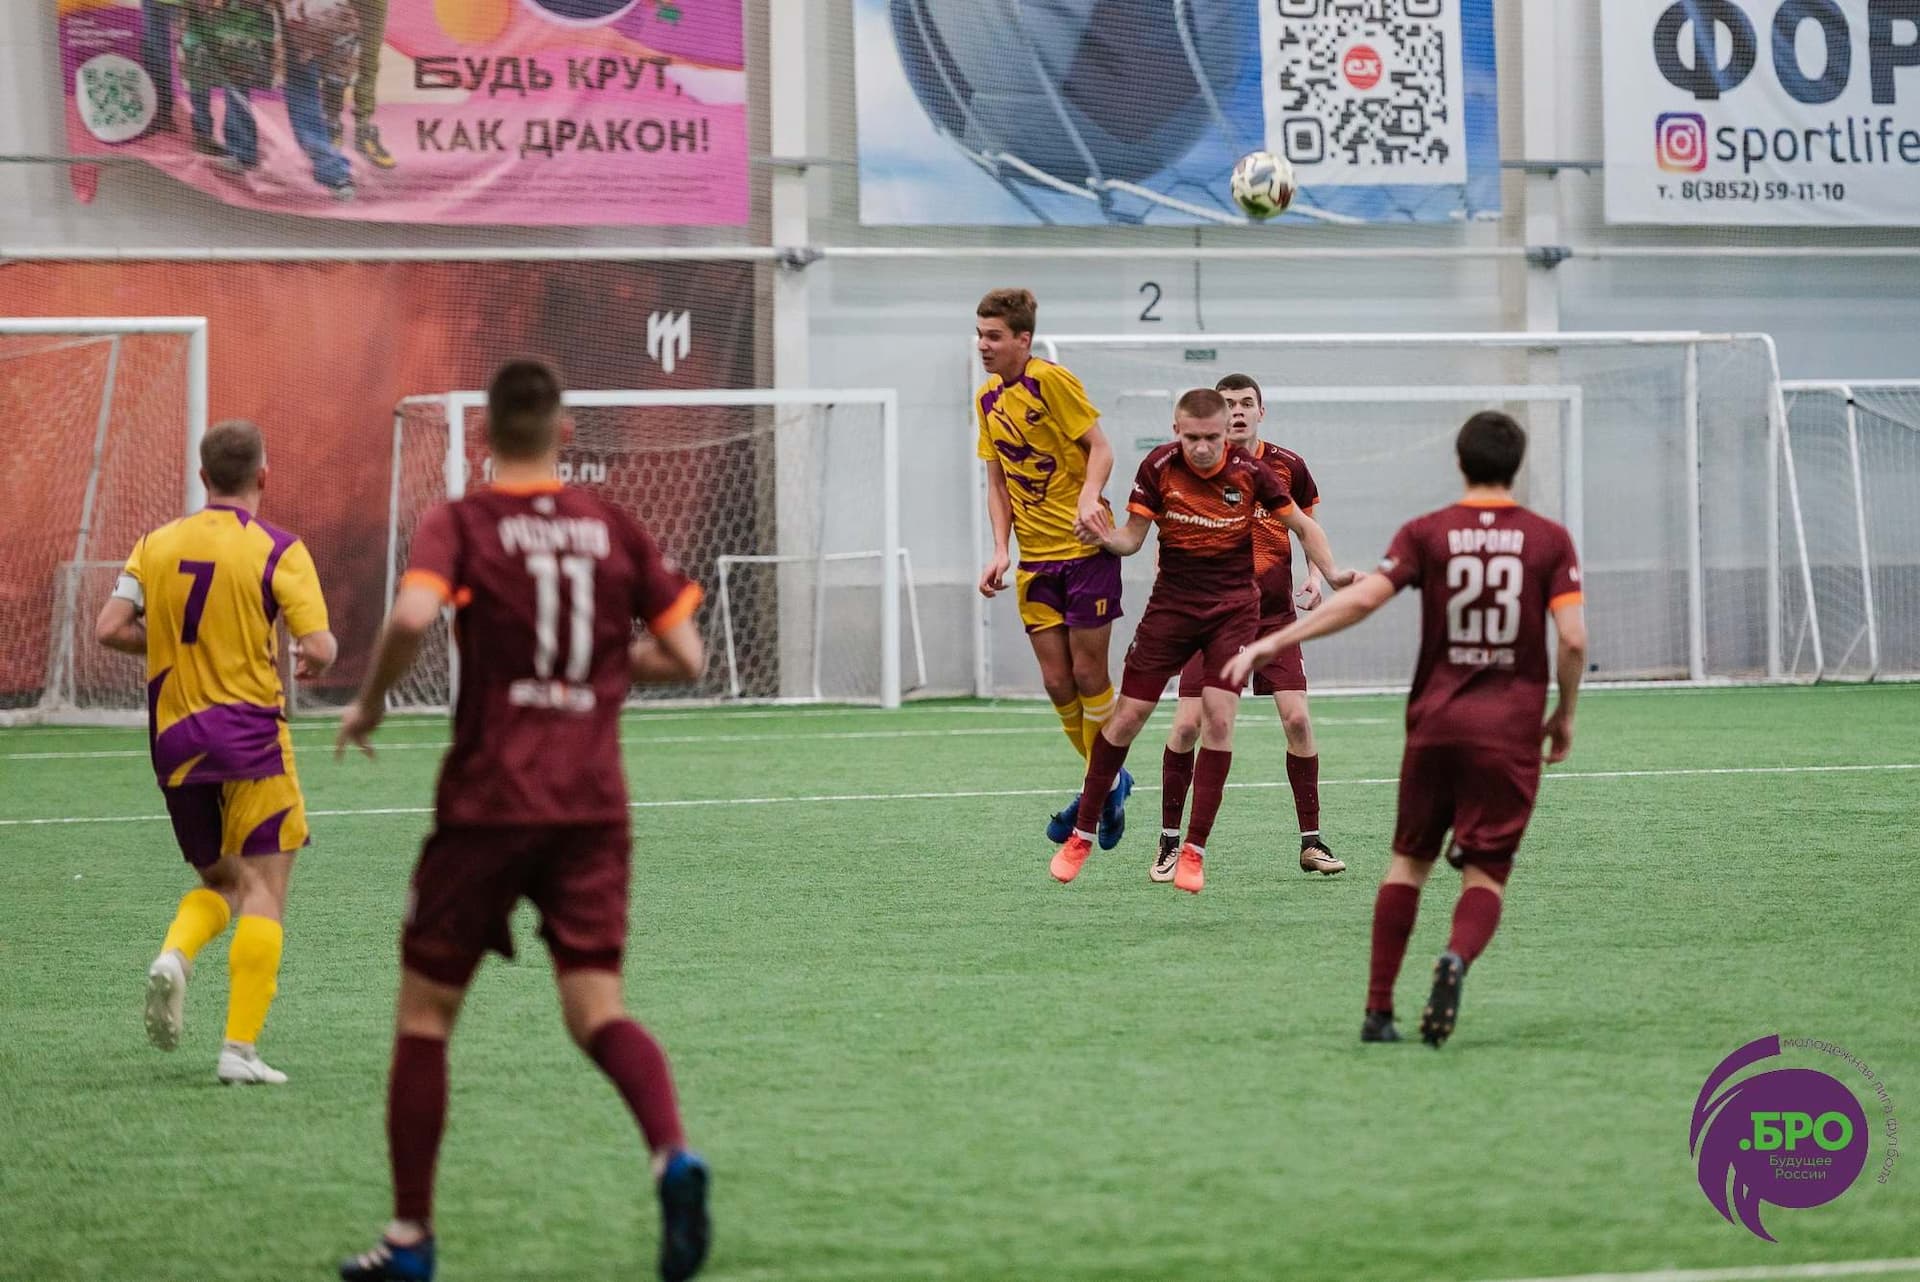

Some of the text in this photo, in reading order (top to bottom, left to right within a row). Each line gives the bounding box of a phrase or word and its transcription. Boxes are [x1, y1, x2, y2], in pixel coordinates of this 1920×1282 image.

[413, 56, 682, 97] БУДЬ КРУТ,
[416, 118, 710, 159] КАК ДРАКОН!
[1715, 117, 1920, 174] sportlife
[1682, 181, 1759, 201] 8(3852)
[1764, 183, 1845, 202] 59-11-10
[1139, 281, 1162, 322] 2
[178, 559, 216, 645] 7
[525, 553, 596, 683] 11
[1446, 554, 1524, 645] 23
